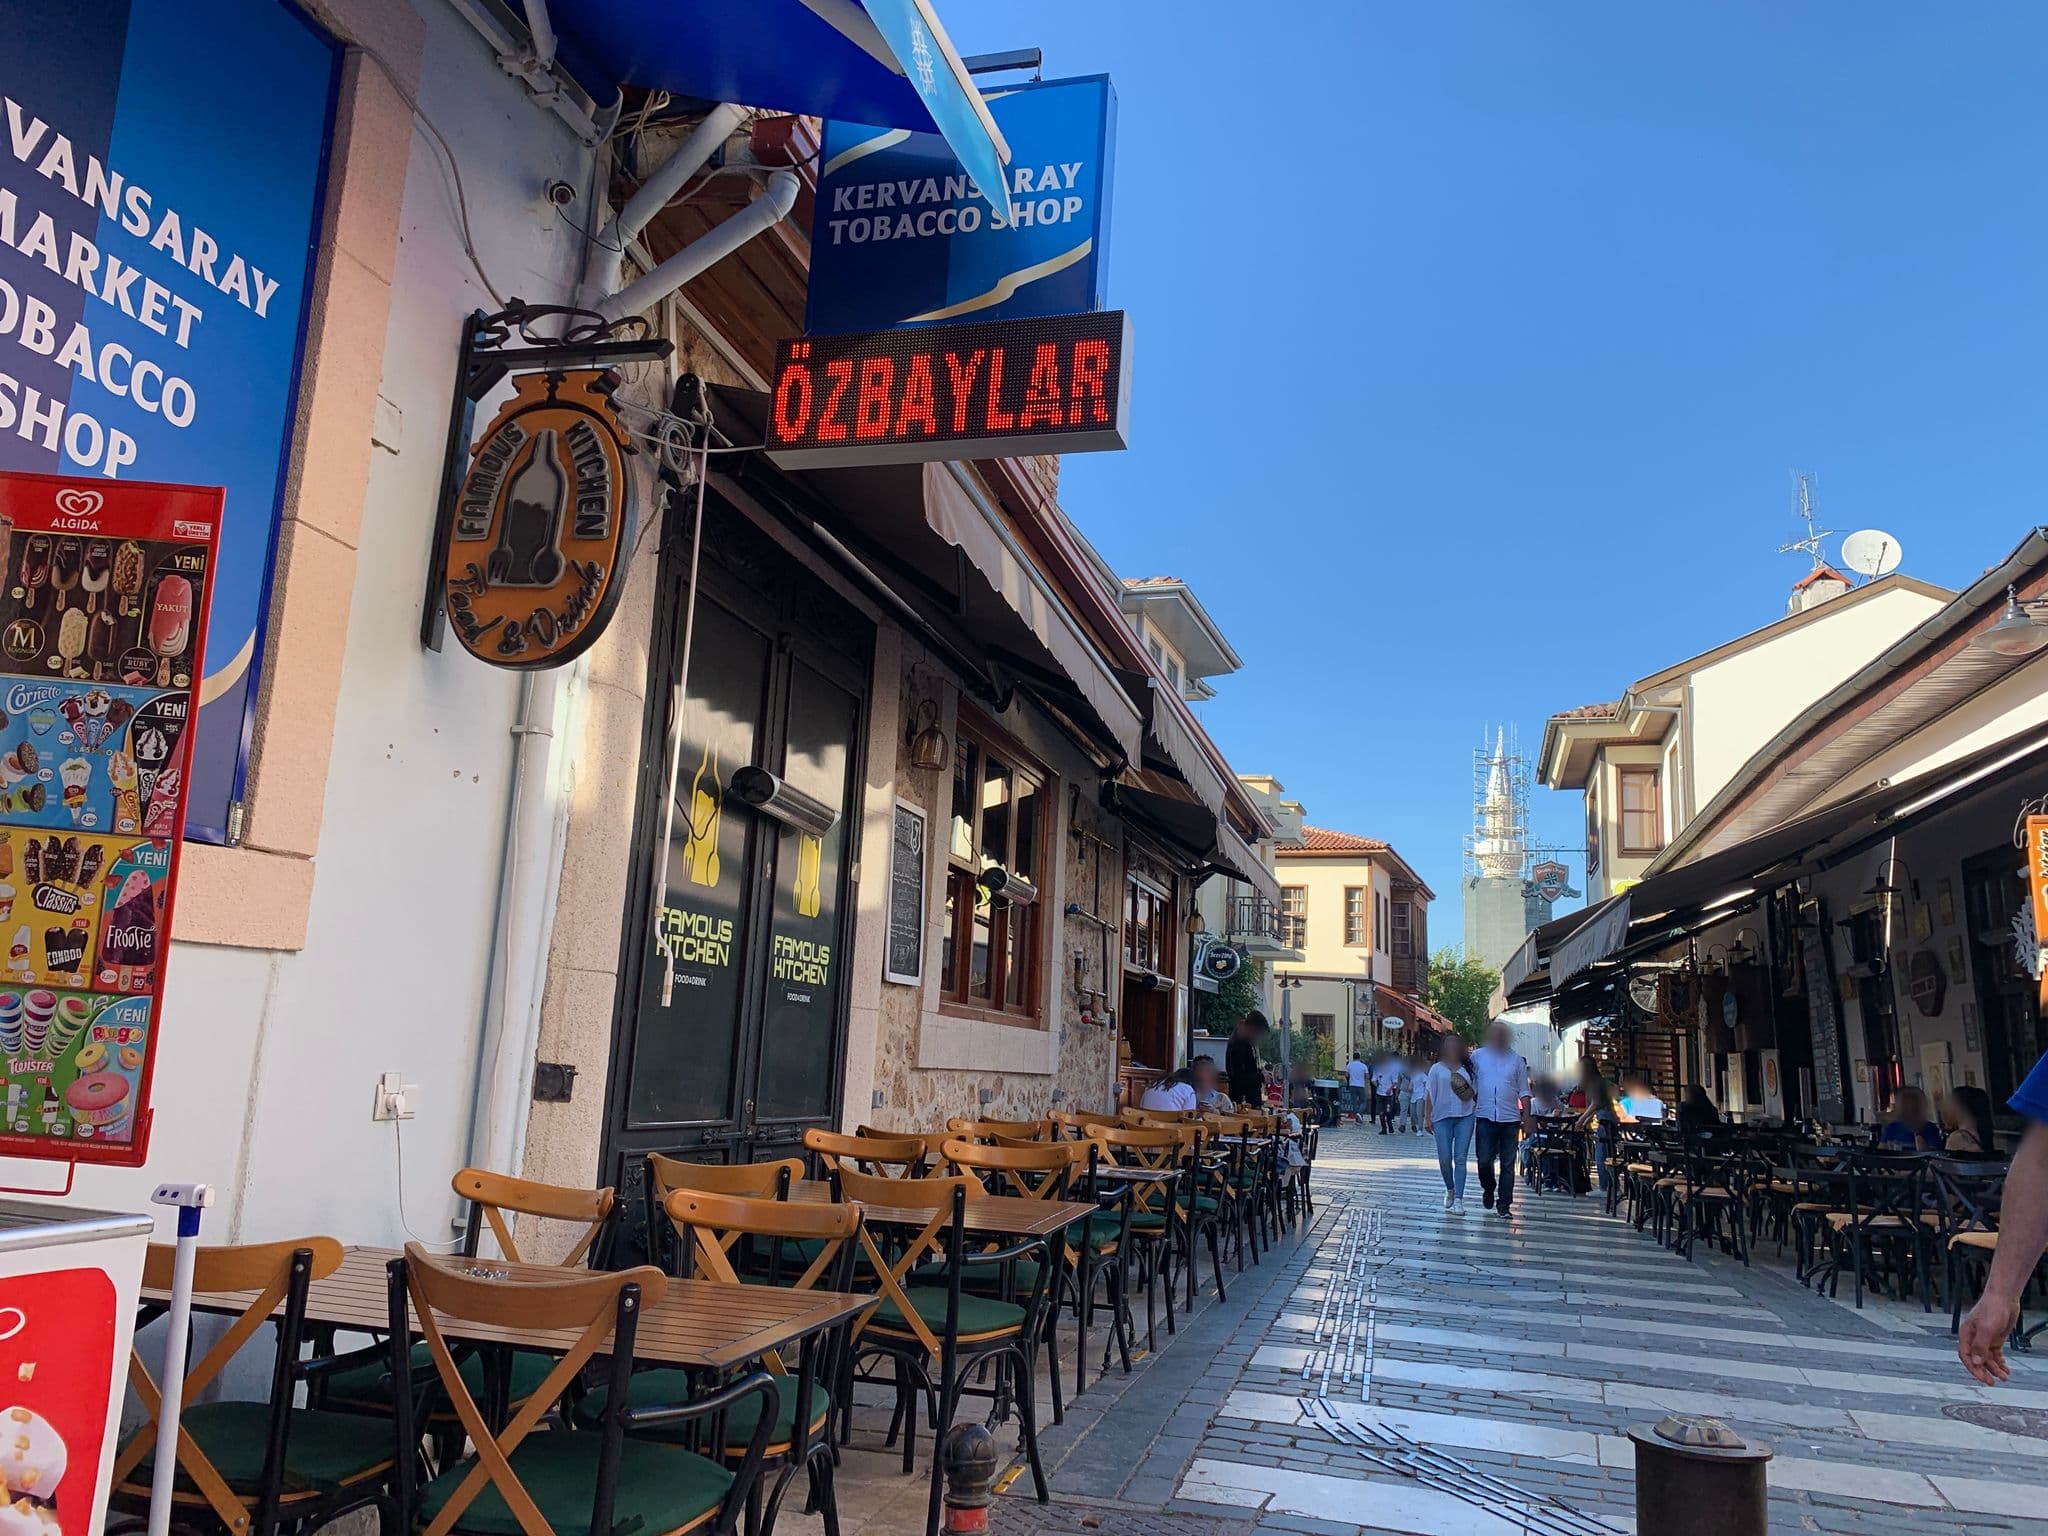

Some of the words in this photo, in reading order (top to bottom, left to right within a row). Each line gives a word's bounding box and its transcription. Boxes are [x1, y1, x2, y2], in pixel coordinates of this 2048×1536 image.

[5, 96, 280, 319] VANSARAY
[833, 162, 1083, 212] KERVANSRAY
[829, 206, 982, 246] TOBACCO
[990, 196, 1083, 230] SHOP
[774, 339, 1110, 443] ÖZBAYLAR
[0, 372, 137, 480] SHOP
[456, 421, 527, 538] FAMOUS
[565, 420, 610, 537] KITCHEN
[156, 603, 188, 613] YAKUT
[6, 683, 61, 715] Cornetto
[37, 885, 77, 913] Classics
[773, 957, 828, 986] KITCHEN
[774, 935, 831, 966] FAMOUS
